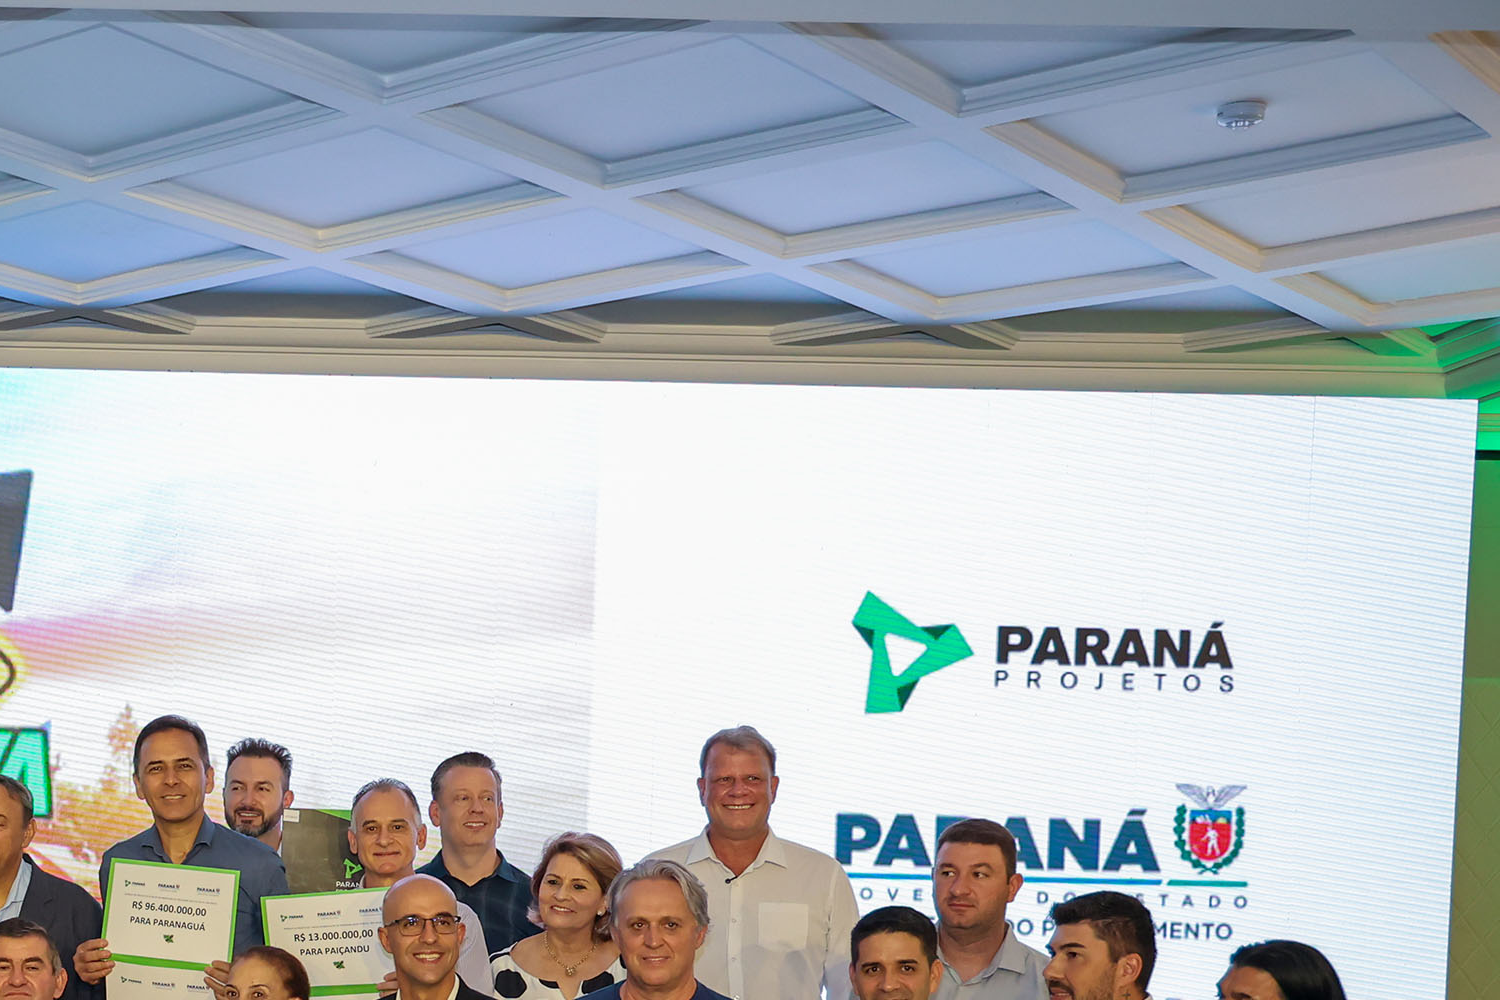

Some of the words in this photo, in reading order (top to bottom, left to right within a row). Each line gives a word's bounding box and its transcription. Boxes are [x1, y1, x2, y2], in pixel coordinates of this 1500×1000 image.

[996, 622, 1234, 669] PARANÁ
[994, 670, 1234, 692] PROJETOS
[132, 901, 142, 910] R$
[145, 902, 206, 916] 96.400.000,00
[130, 916, 151, 925] PARA
[153, 919, 205, 931] PARANAGUÁ
[294, 934, 306, 942] R$
[309, 929, 373, 941] 13.000.000,00
[300, 948, 323, 956] PARA
[325, 946, 369, 955] PAIÇANDU
